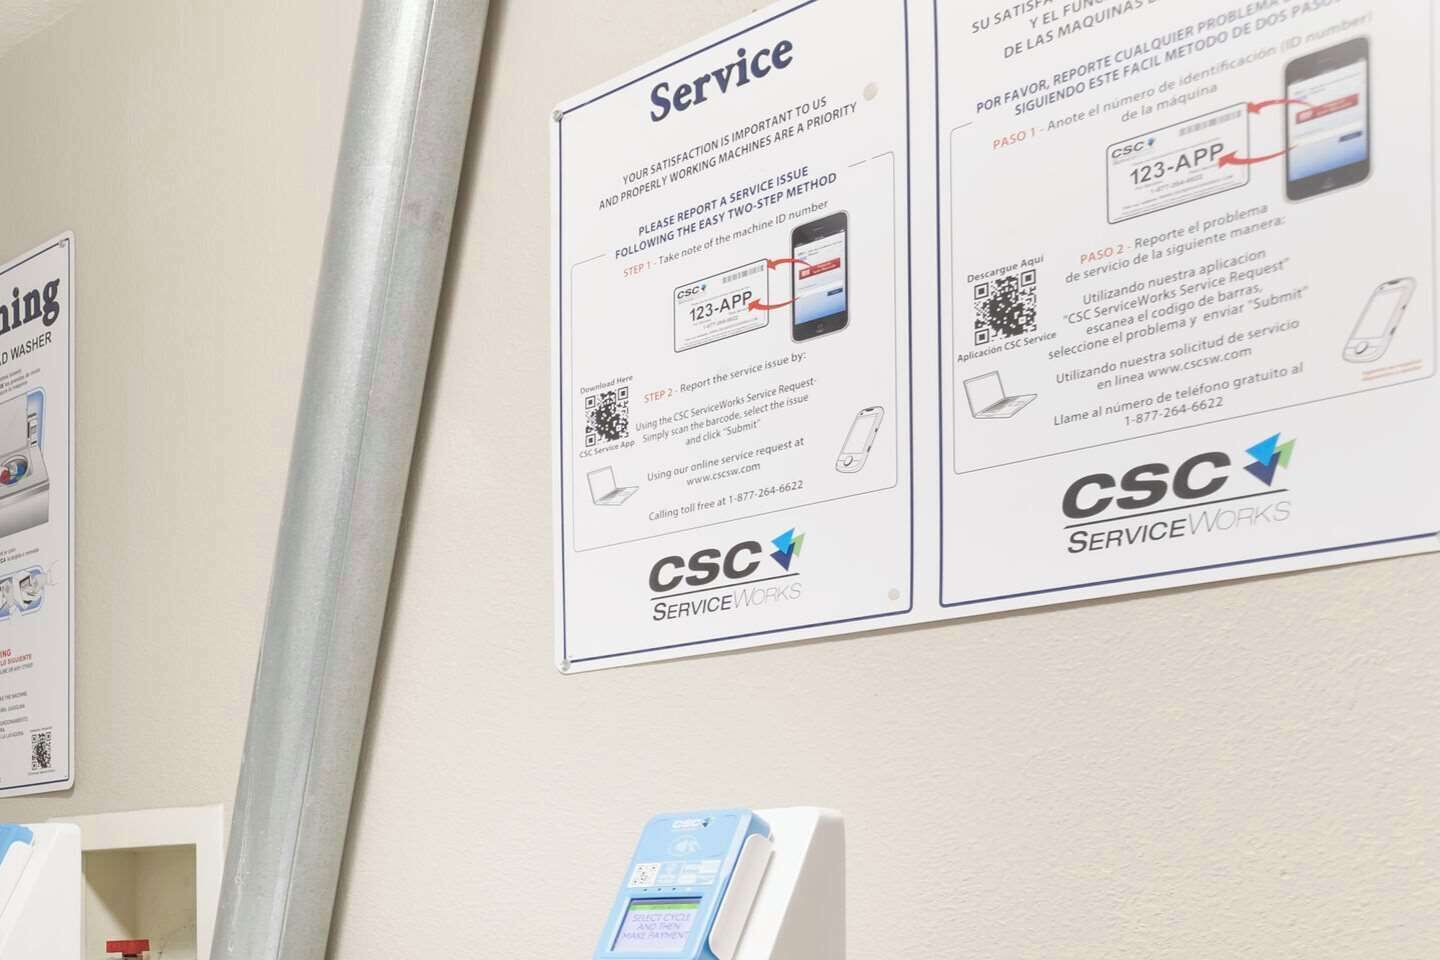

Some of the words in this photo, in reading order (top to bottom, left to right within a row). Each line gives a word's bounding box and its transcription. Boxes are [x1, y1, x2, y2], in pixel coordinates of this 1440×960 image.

[650, 40, 792, 122] Service
[623, 167, 649, 185] YOUR
[650, 141, 718, 173] SATISFACTION
[721, 135, 729, 146] IS
[732, 109, 793, 142] IMPORTANT
[797, 104, 809, 116] TO
[813, 96, 827, 111] US
[1130, 143, 1224, 184] 123-APP
[638, 213, 675, 236] PLEASE
[678, 201, 716, 223] REPORT
[720, 196, 728, 207] A
[730, 179, 774, 203] SERVICE
[776, 166, 809, 187] ISSUE
[689, 290, 753, 322] 123-APP
[1082, 281, 1145, 306] Utilizando
[1148, 267, 1196, 288] nuestra
[11, 332, 52, 361] WASHER
[1056, 361, 1117, 385] Utilizando
[1120, 351, 1167, 370] nuestra
[1169, 336, 1224, 360] solicitud
[1227, 331, 1244, 344] de
[1247, 318, 1300, 340] servicio
[1096, 378, 1112, 390] en
[1147, 346, 1252, 380] www.cscsw.com
[1054, 408, 1089, 426] Llame
[1092, 405, 1102, 417] al
[1105, 393, 1154, 415] número
[1156, 391, 1173, 404] de
[1175, 378, 1230, 404] teléfono
[1233, 366, 1289, 392] gratuito
[1291, 362, 1304, 378] al
[1124, 396, 1224, 427] 1-877-264-6622
[686, 462, 761, 487] www.cscsw.com
[1060, 451, 1232, 520] CSC
[648, 506, 679, 521] Calling
[681, 500, 695, 513] toll
[697, 497, 715, 510] free
[716, 495, 726, 506] at
[729, 480, 804, 505] 1-877-264-6622
[648, 539, 762, 593] CSC
[631, 912, 662, 922] SELECT
